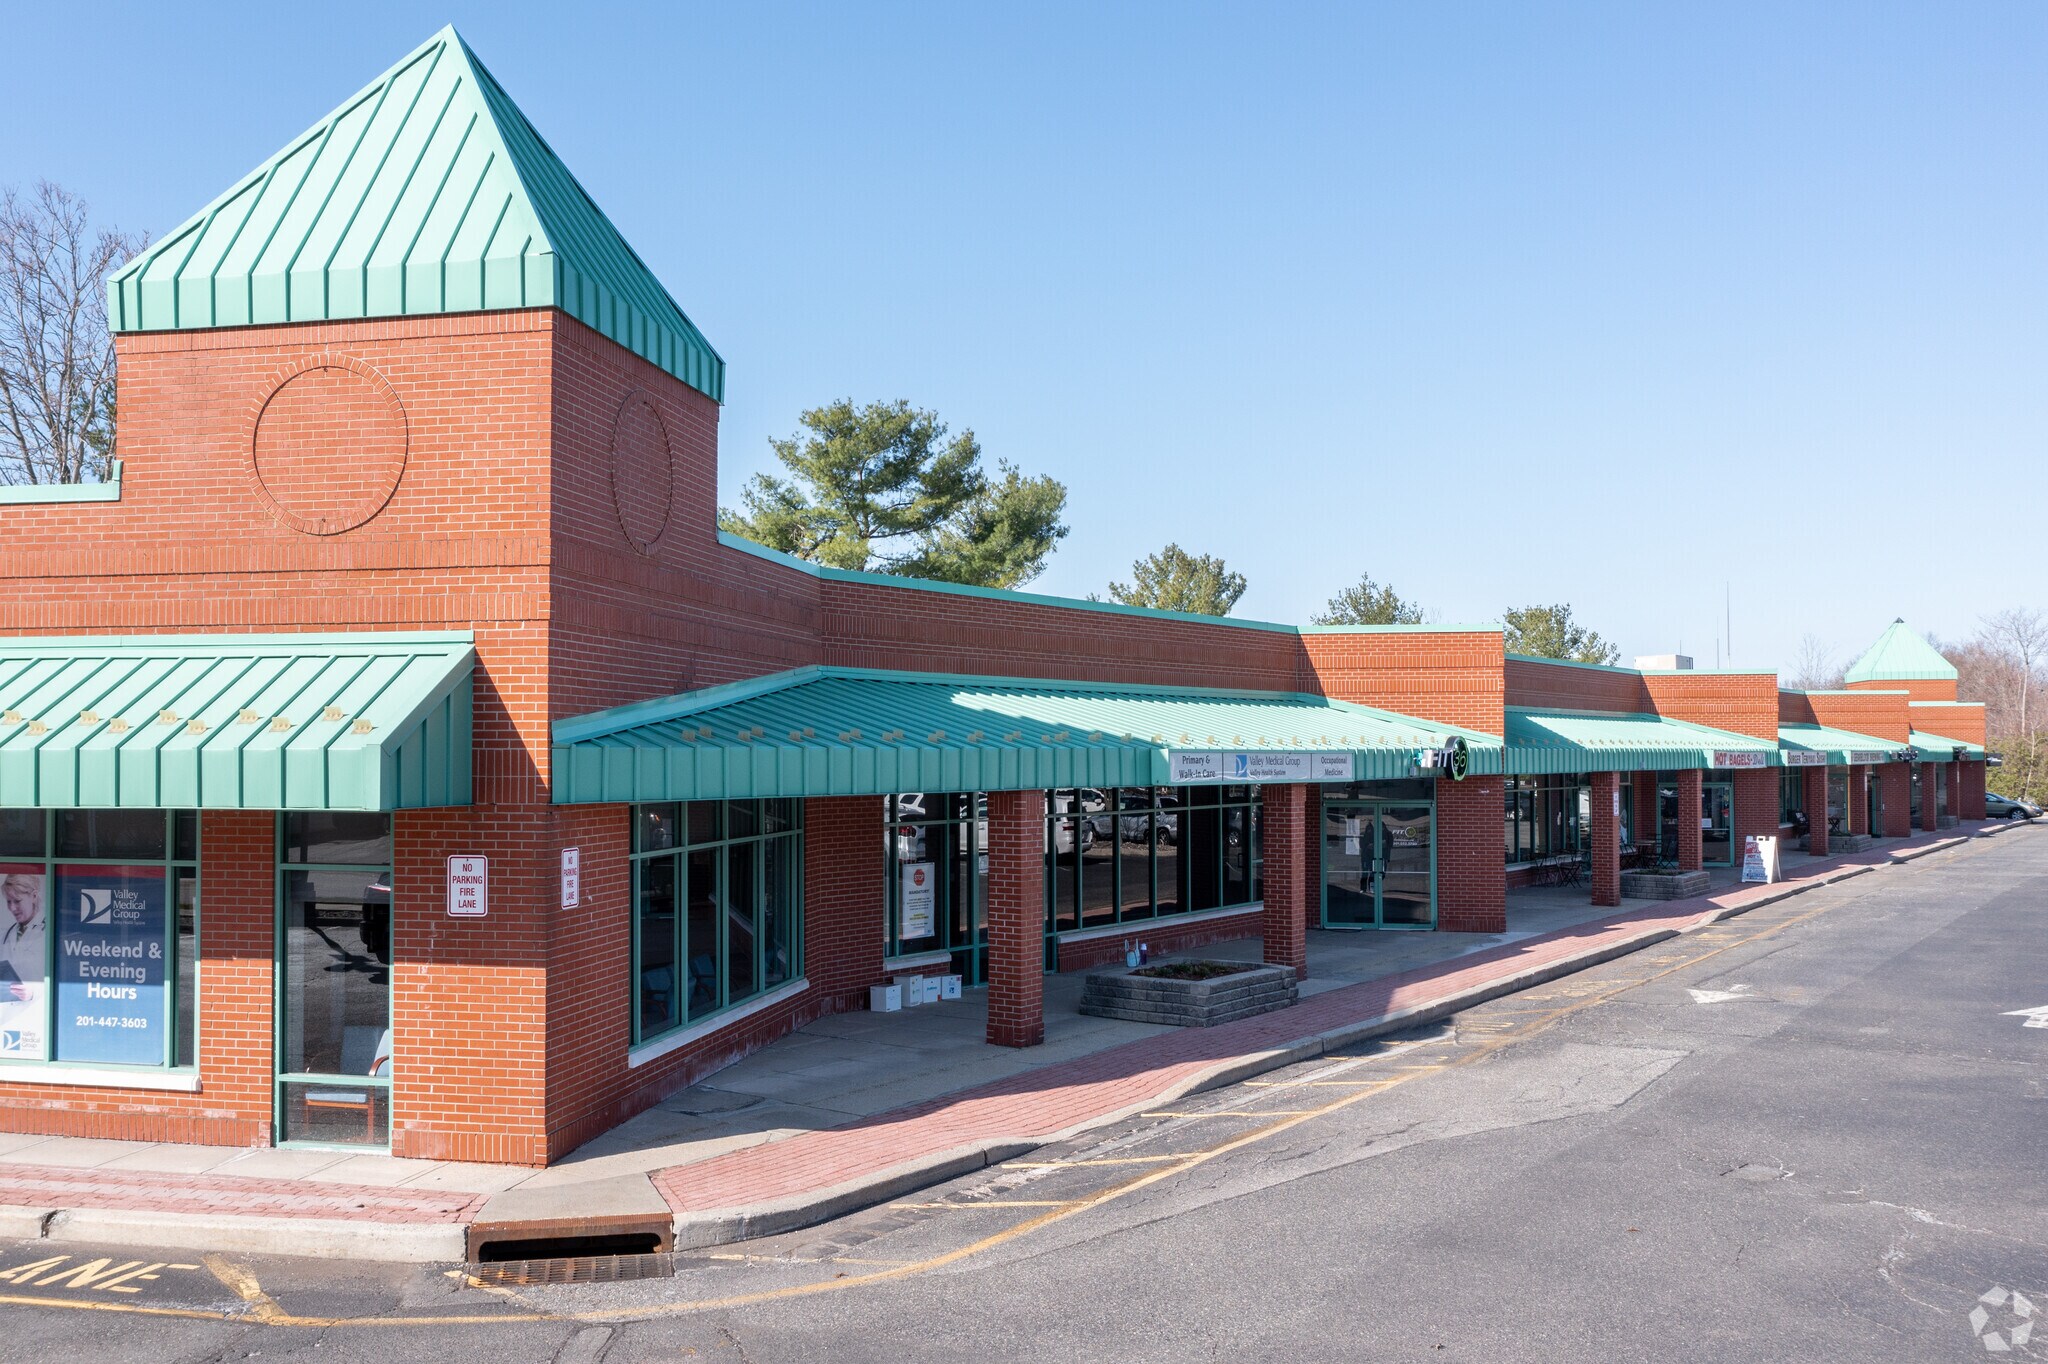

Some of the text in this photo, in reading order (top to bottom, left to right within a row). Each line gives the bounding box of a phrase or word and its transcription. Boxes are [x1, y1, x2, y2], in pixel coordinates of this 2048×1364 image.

[1182, 755, 1211, 766] Primary &
[1249, 755, 1301, 767] Valley Medical Group
[1320, 756, 1347, 766] Occupational
[1714, 752, 1727, 766] HOT
[1179, 769, 1216, 778] Walk-In Care
[568, 856, 573, 865] NO
[462, 863, 473, 872] NO
[563, 867, 577, 876] PARKING
[452, 875, 483, 884] PARKING
[566, 879, 574, 888] FIRE
[113, 889, 138, 901] Valley
[460, 887, 475, 896] FIRE
[565, 891, 575, 900] LANE
[113, 900, 146, 910] Medical
[458, 900, 477, 909] LANE
[113, 909, 140, 920] Group
[64, 940, 162, 959] Weekend &
[79, 961, 146, 984] Evening
[87, 982, 137, 1000] Hours
[76, 1016, 148, 1028] 201-447-3603
[0, 1254, 201, 1293] ANE
